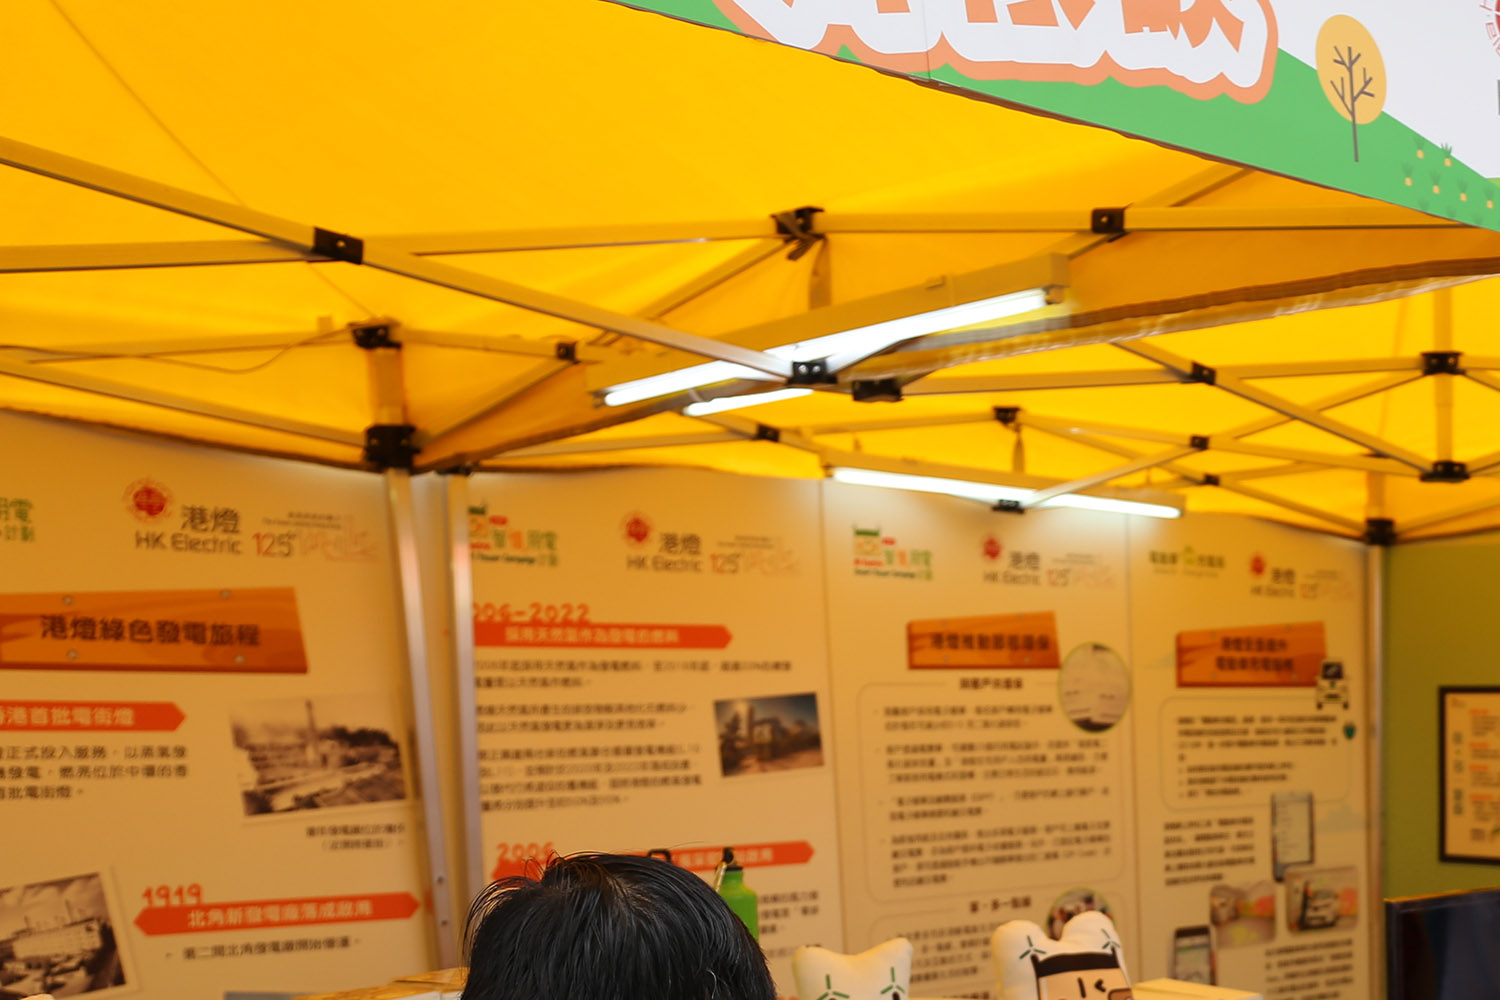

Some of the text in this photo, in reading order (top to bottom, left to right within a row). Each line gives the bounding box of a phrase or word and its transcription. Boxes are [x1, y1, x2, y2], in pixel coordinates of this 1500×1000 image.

[181, 505, 240, 534] 港燈
[135, 530, 166, 550] HK
[171, 532, 242, 555] Electric
[660, 533, 702, 555] 港燈
[627, 557, 648, 571] HK
[652, 556, 703, 573] Electric
[40, 614, 261, 648] 港燈綠色發電旅程
[142, 884, 202, 907] 1919
